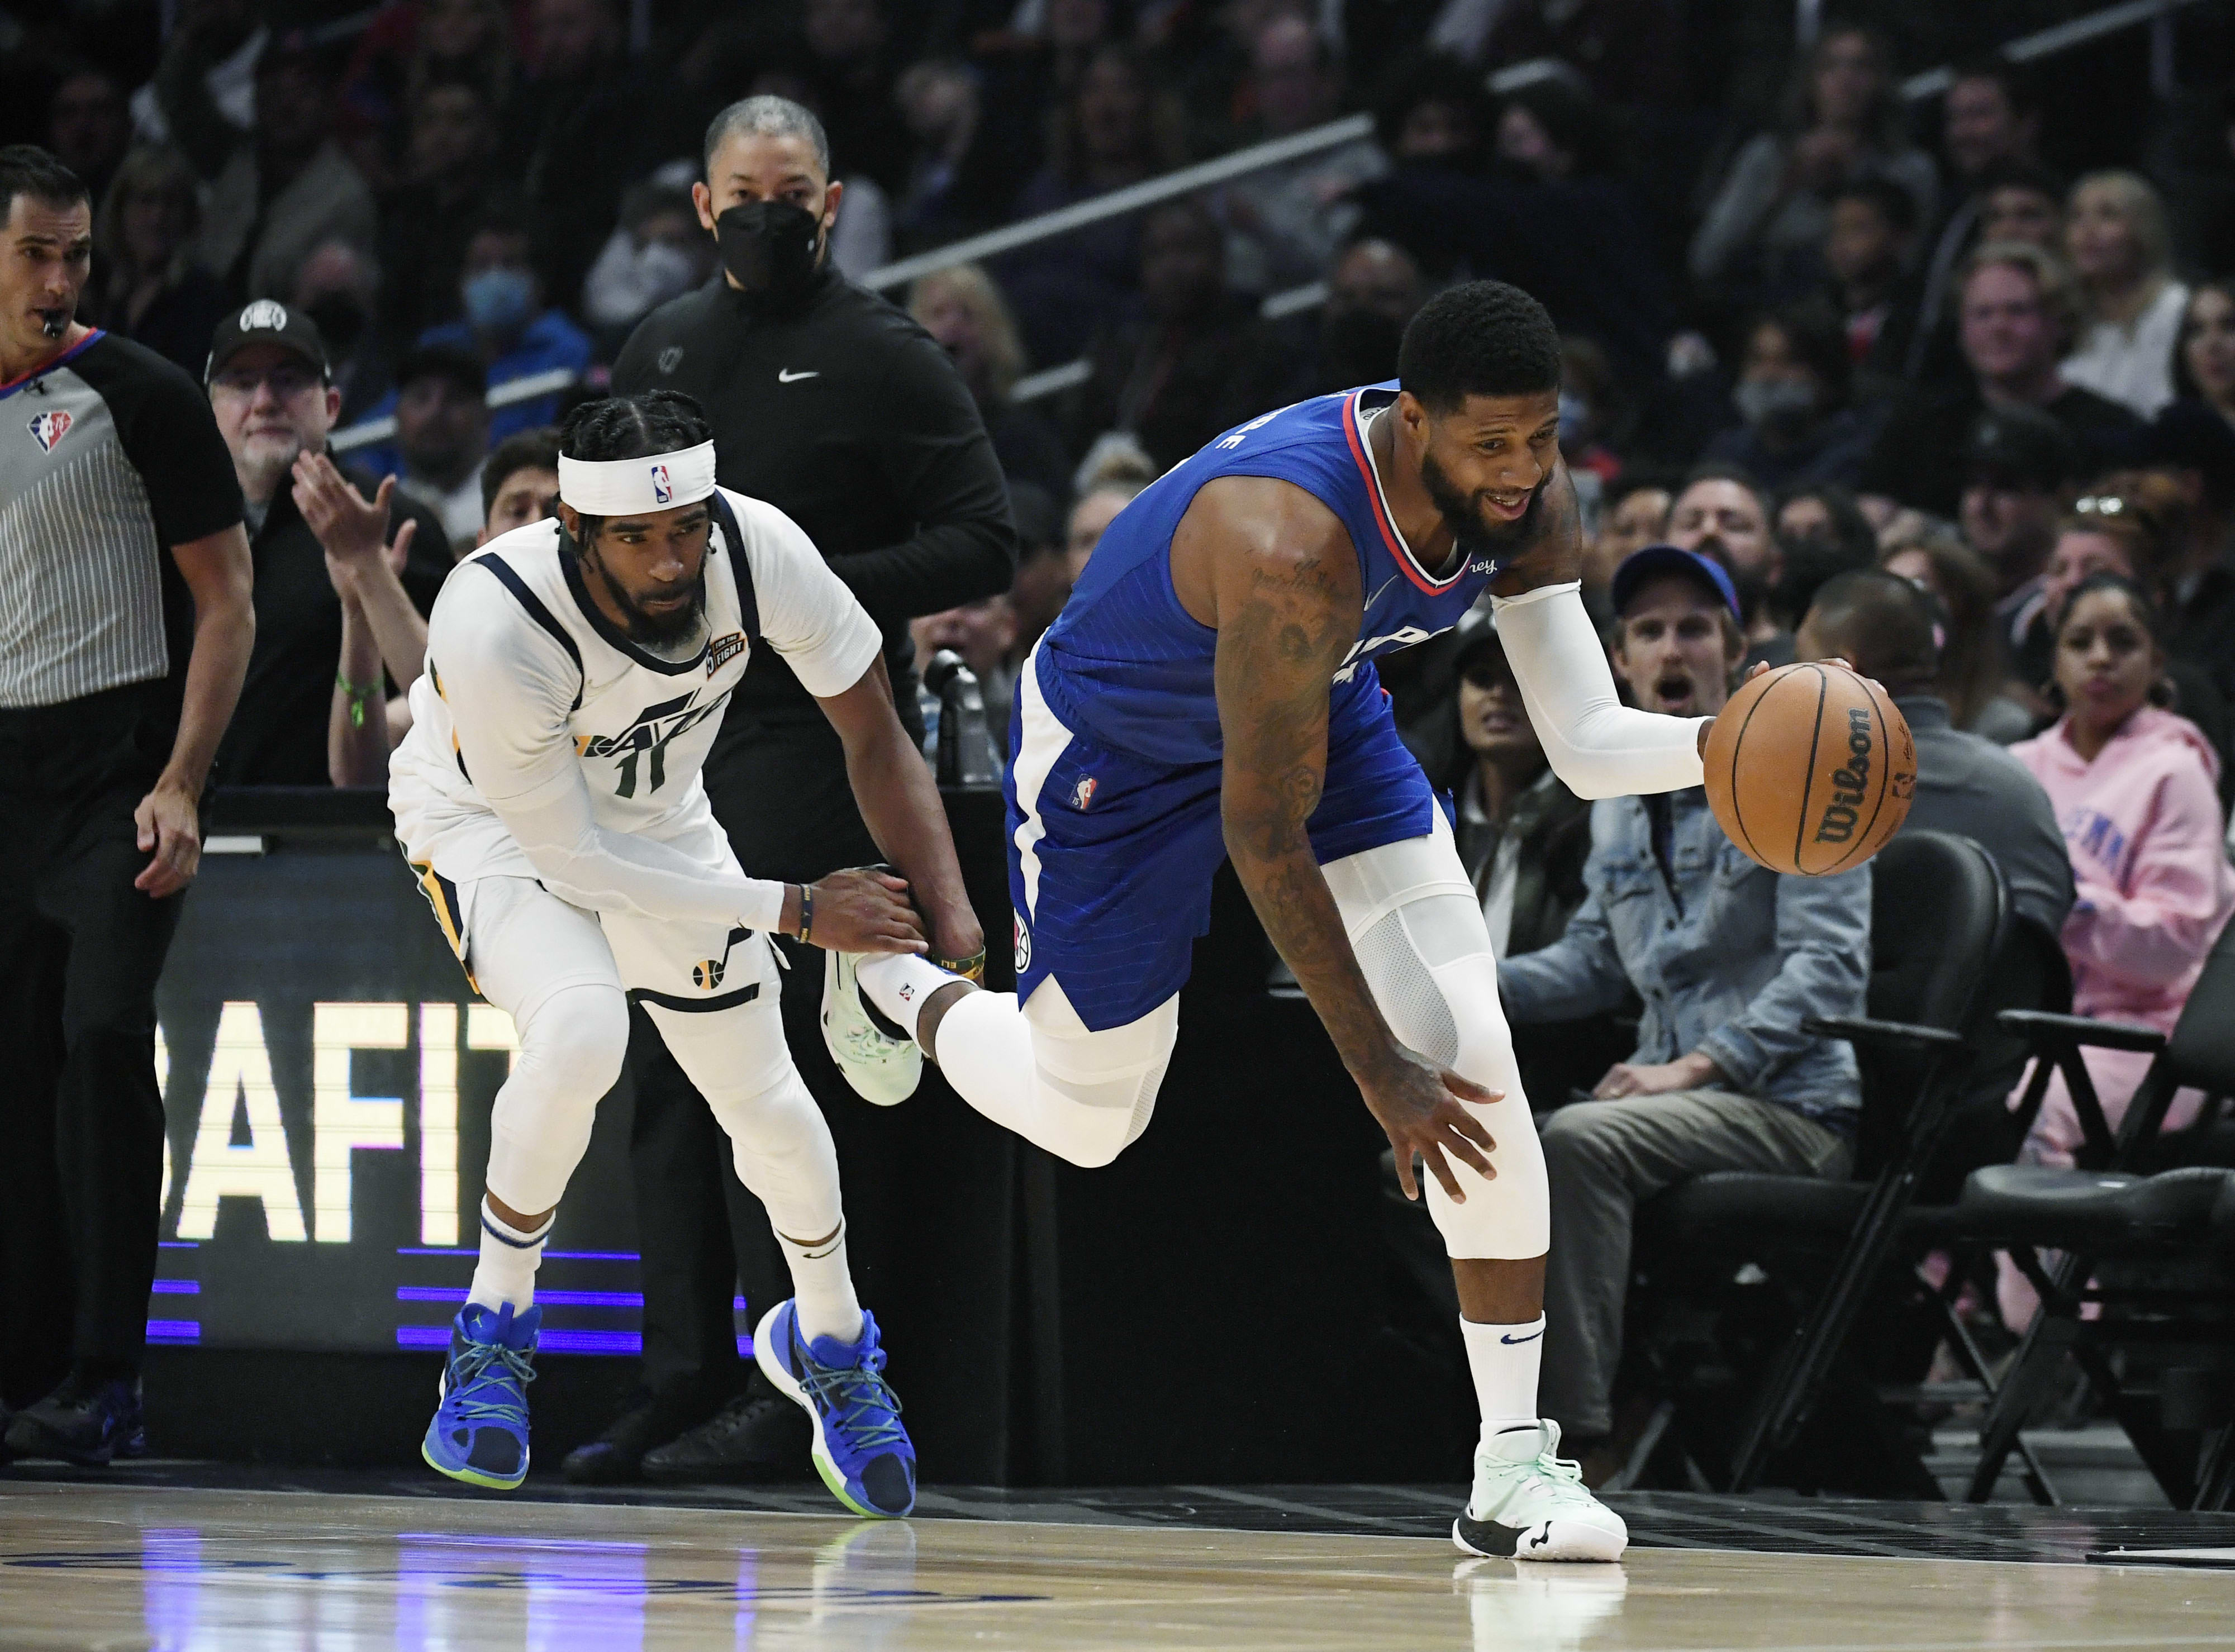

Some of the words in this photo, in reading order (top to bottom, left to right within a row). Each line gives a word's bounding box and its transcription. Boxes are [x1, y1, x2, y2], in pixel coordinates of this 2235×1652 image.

[716, 641, 743, 665] FIGHT
[614, 746, 665, 799] 11
[1814, 708, 1872, 844] Wilson
